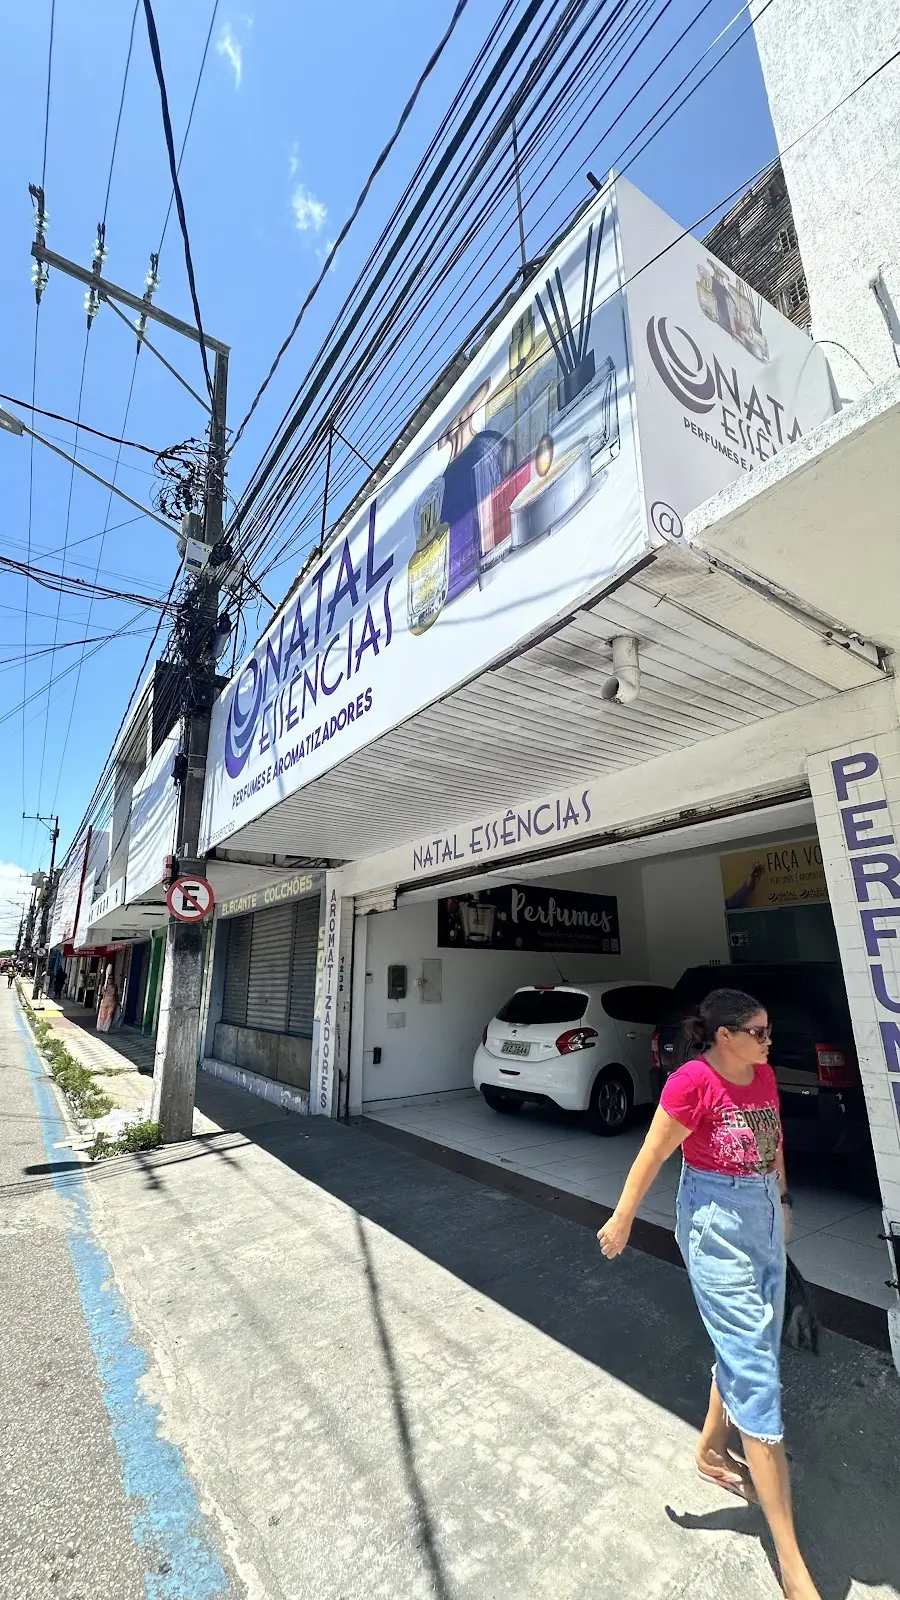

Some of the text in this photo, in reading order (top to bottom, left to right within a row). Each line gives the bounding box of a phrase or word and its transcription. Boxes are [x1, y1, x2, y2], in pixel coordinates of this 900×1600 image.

[684, 416, 739, 464] PERFUMES
[741, 457, 747, 470] E
[262, 499, 393, 705] NATAL
[258, 577, 393, 757] ESSÊNCIAS
[231, 774, 266, 810] PERFUMES
[273, 687, 373, 780] AROMATIZADORES
[413, 789, 592, 871] NATAL ESSÊNCIAS
[766, 849, 799, 872] FAÇA
[182, 885, 200, 911] E
[221, 893, 257, 916] ELEGANTE
[511, 888, 612, 932] Perfumes
[319, 888, 338, 1109] AROMATIZADORES
